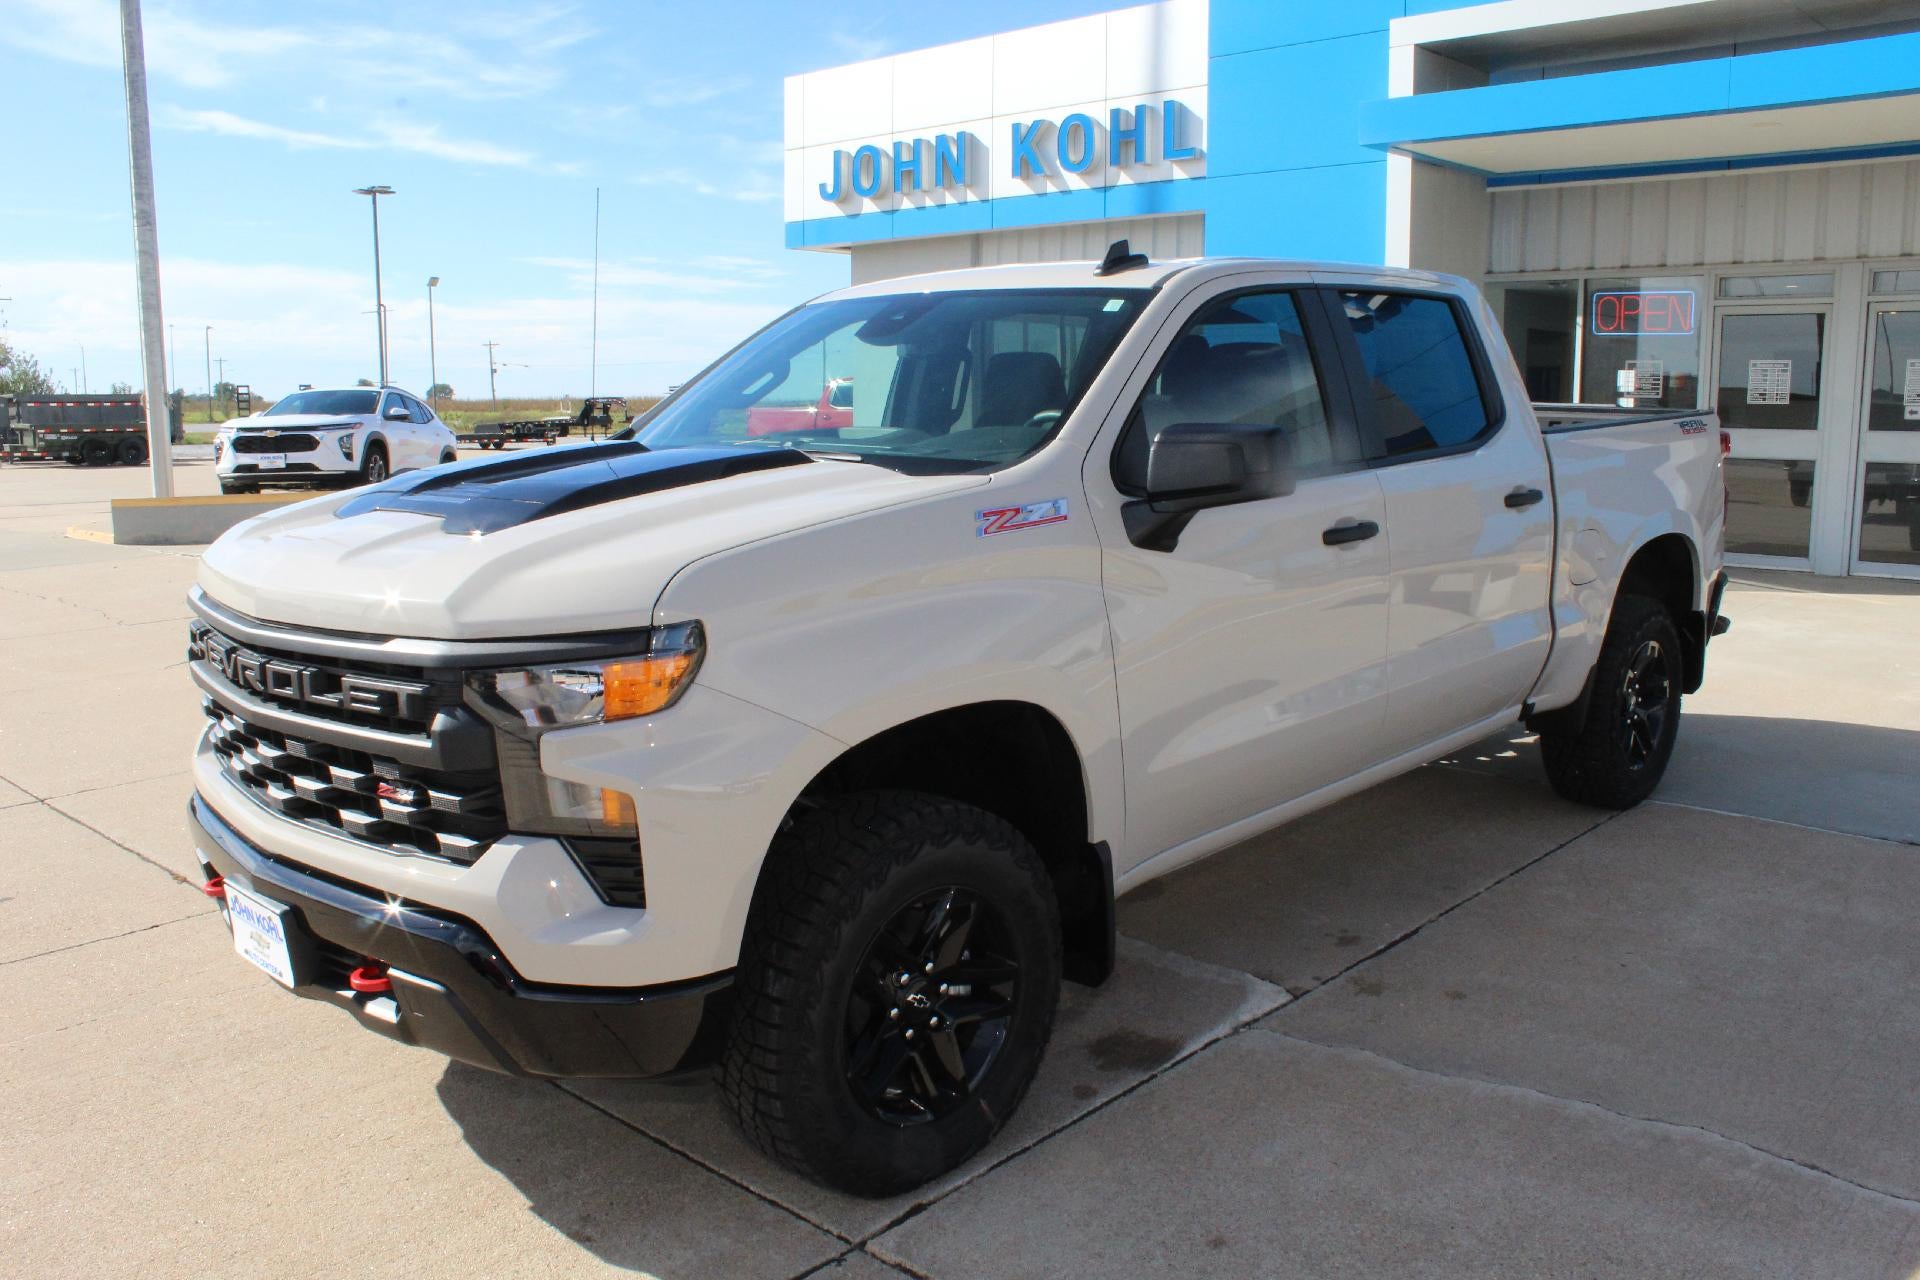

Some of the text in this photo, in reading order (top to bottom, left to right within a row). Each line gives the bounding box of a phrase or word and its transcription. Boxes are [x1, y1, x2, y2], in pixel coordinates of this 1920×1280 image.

[819, 100, 1197, 201] JOHN KOHL
[1597, 295, 1692, 331] OPEN
[975, 497, 1068, 537] Z71
[188, 619, 428, 718] HEVROLET
[229, 895, 255, 922] JOHN
